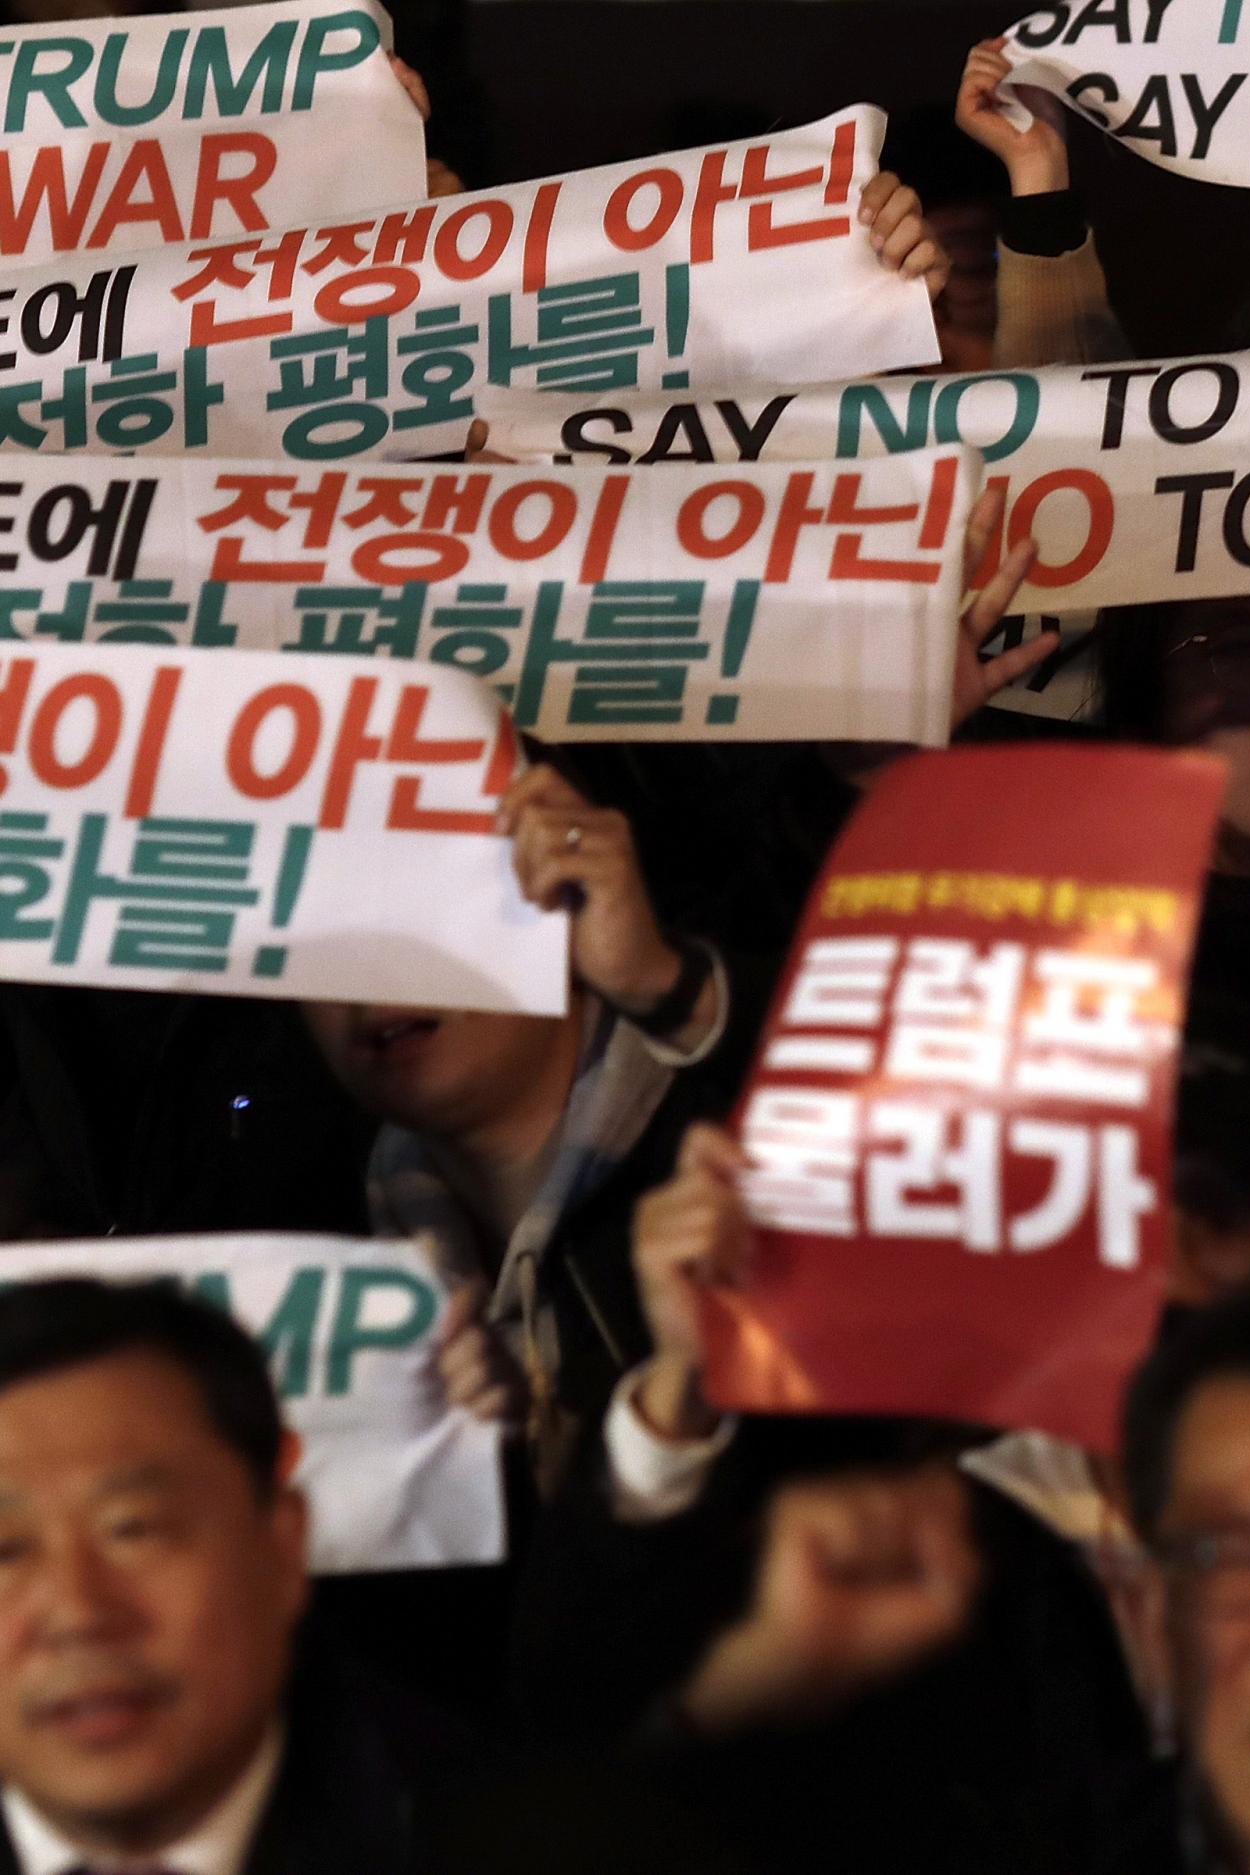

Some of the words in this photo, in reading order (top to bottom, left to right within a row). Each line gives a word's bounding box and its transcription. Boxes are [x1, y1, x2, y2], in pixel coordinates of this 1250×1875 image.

[0, 10, 381, 134] RUMP
[0, 131, 278, 256] WAR
[0, 264, 138, 371] 에
[170, 182, 562, 348] 전쟁이
[602, 119, 856, 266] 아닌
[265, 262, 690, 460] 평화를!
[552, 393, 799, 466] SAY
[835, 372, 1040, 464] NO
[1080, 361, 1240, 450] TO
[0, 478, 159, 582] 에
[196, 471, 630, 586] 전쟁이
[676, 455, 959, 585] 아닌
[225, 674, 518, 835] 아닌
[762, 934, 1182, 1106] 트럼프
[738, 1087, 1156, 1271] 물러가
